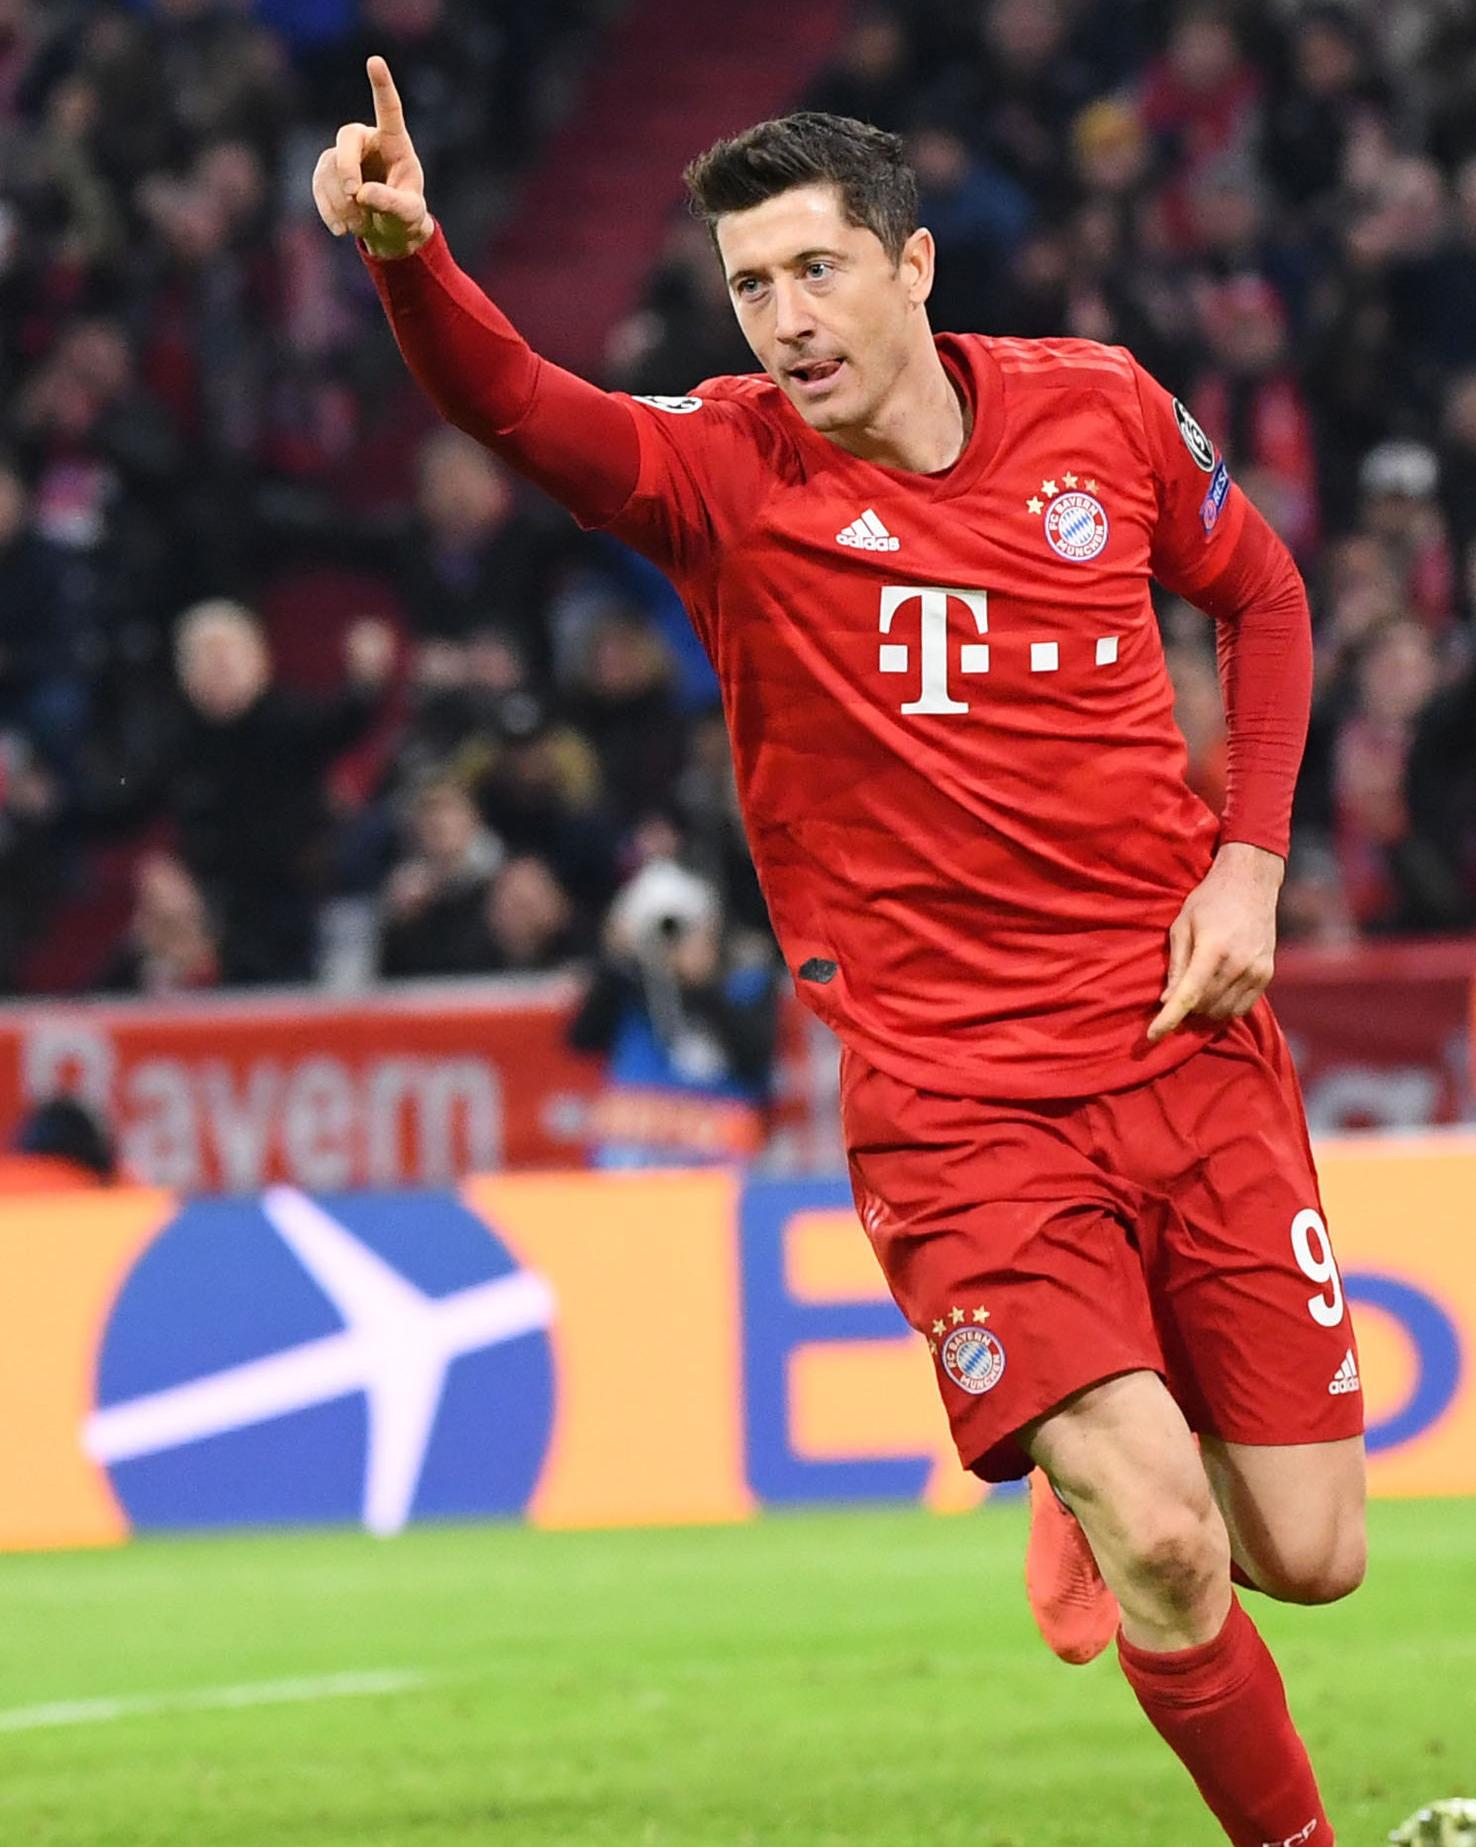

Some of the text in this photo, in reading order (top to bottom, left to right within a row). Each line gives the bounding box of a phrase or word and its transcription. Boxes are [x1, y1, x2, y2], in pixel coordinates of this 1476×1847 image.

[1054, 496, 1099, 517] BAYERN
[835, 532, 900, 551] adidas
[879, 586, 989, 715] T
[1290, 1208, 1344, 1327] 9
[948, 1331, 991, 1351] BAYERN
